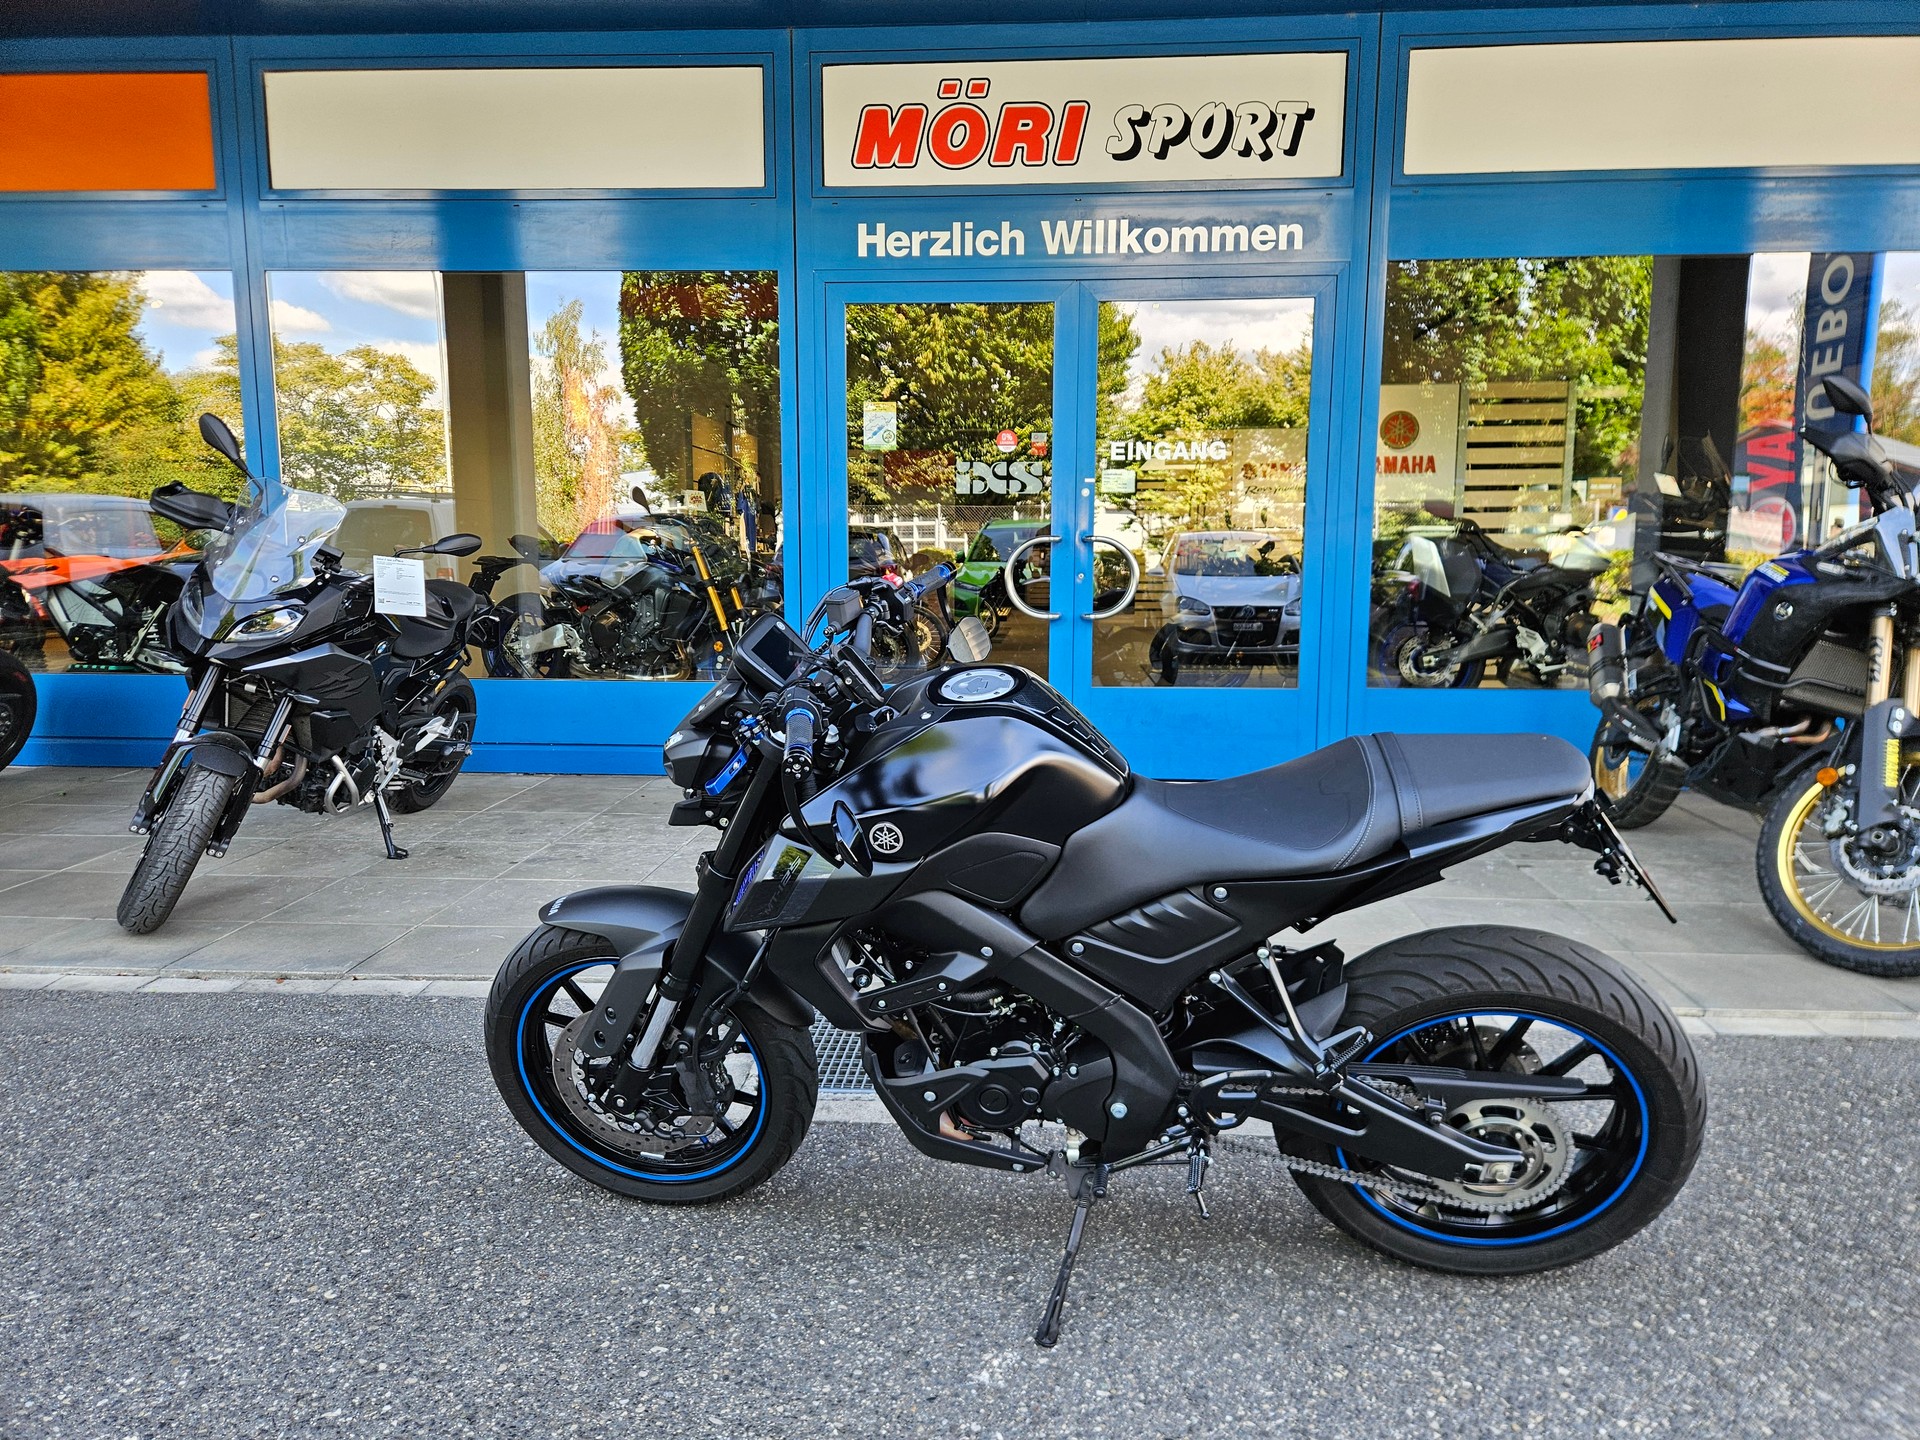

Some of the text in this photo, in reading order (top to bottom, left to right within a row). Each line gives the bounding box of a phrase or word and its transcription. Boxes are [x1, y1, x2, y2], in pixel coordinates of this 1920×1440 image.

[851, 78, 1316, 170] MÖRI SPORT
[857, 218, 1304, 258] Herzlich Willkommen
[1110, 440, 1228, 461] EINGANG
